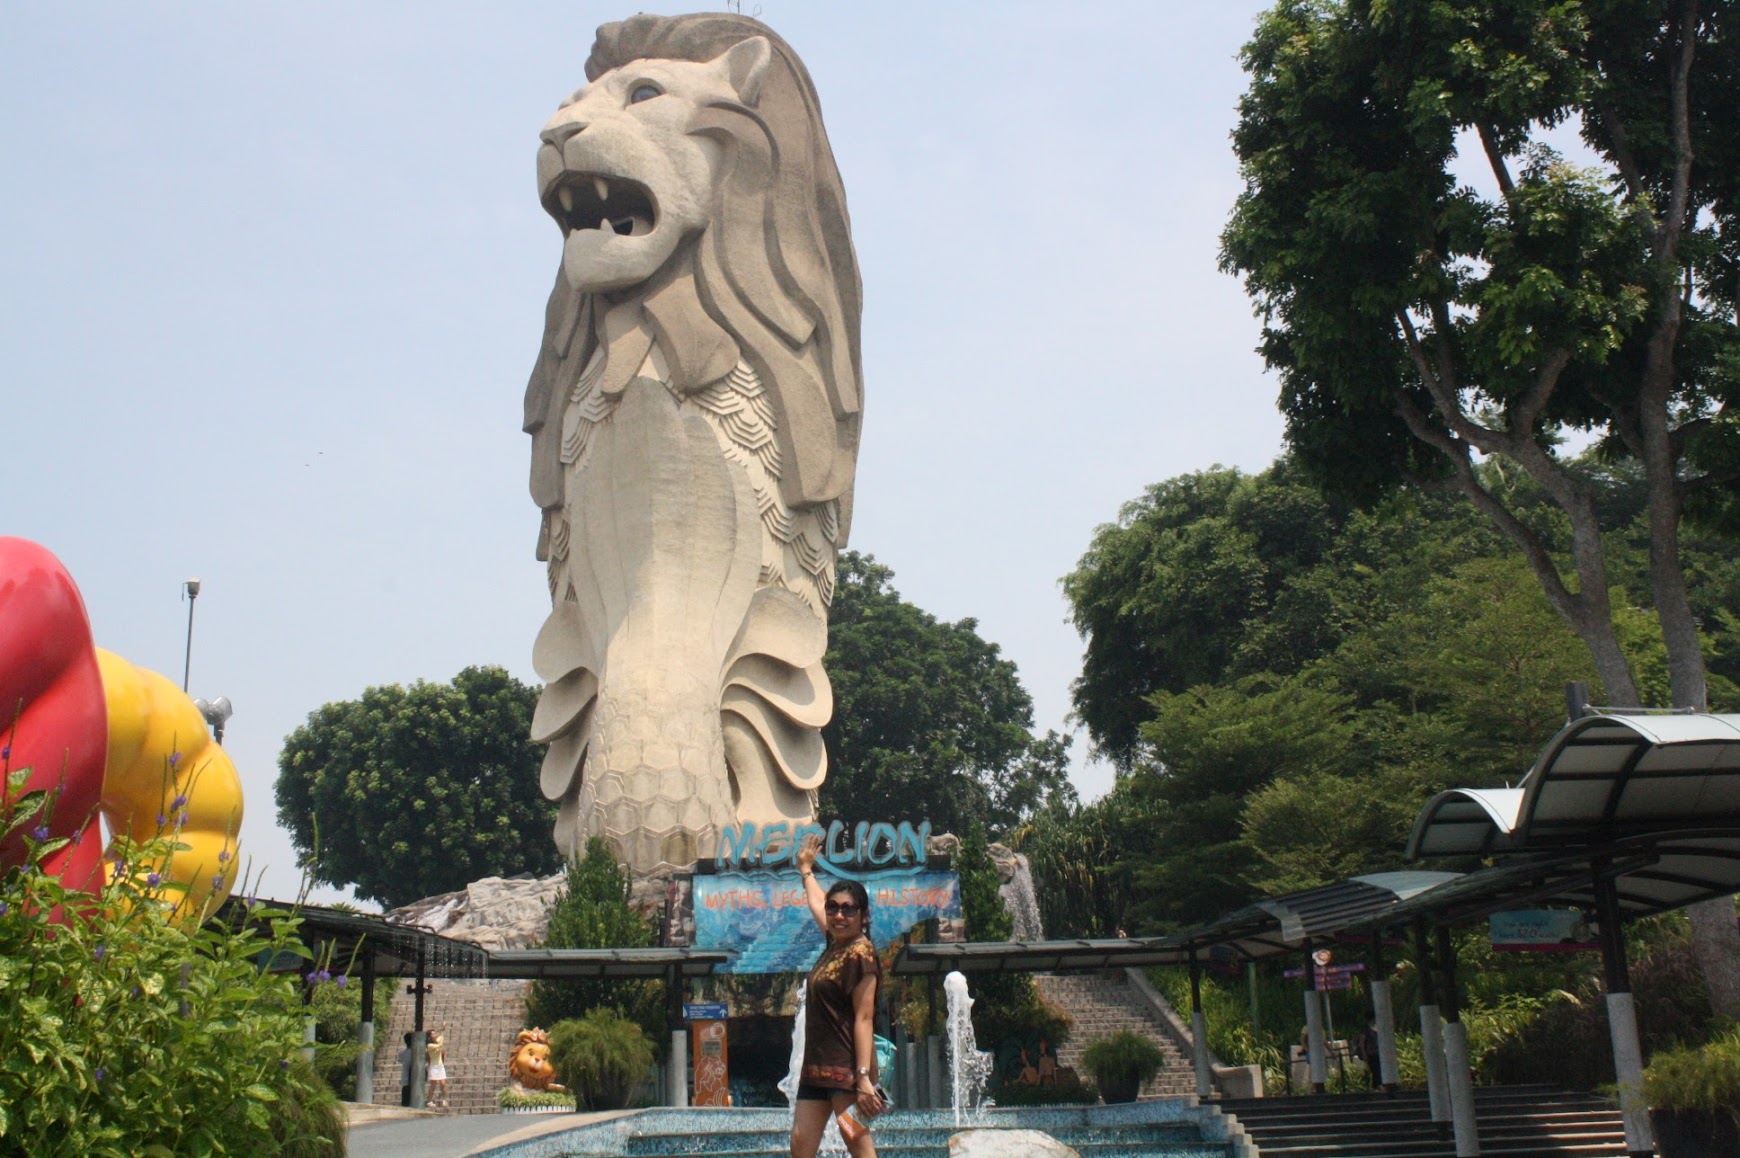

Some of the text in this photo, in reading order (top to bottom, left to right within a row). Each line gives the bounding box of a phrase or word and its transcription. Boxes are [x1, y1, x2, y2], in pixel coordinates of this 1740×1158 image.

[716, 820, 931, 867] MERLION
[705, 888, 768, 910] MYTHS,
[877, 886, 949, 908] HISTORY
